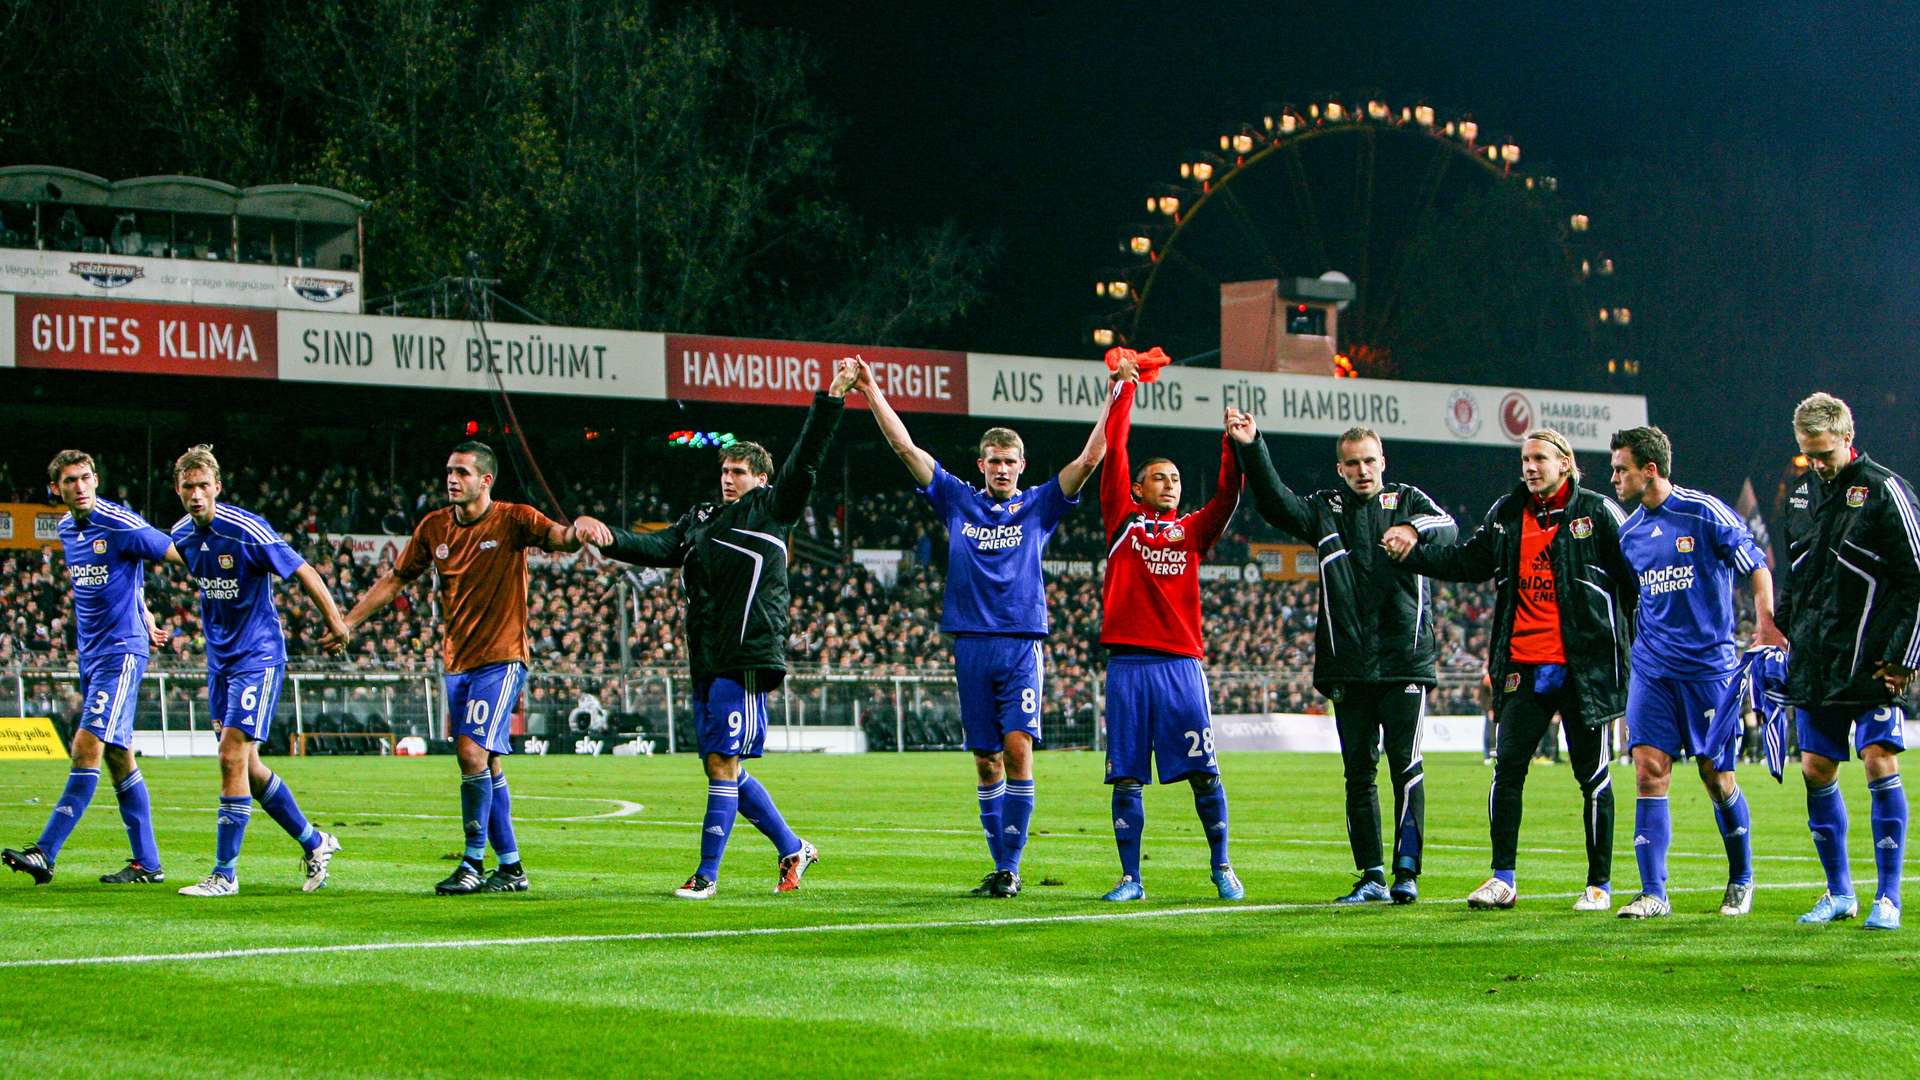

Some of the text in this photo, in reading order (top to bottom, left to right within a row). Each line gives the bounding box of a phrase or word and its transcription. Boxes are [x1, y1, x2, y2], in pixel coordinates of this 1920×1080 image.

[32, 313, 258, 362] GUTES KLIMA
[303, 329, 618, 381] SIND WIR BERÜHMT.
[683, 350, 821, 392] HAMBURG
[992, 369, 1043, 403] AUS
[1222, 380, 1267, 417] FÜR
[1283, 388, 1407, 425] HAMBURG.
[1540, 401, 1611, 421] HAMBURG
[977, 536, 1023, 550] ENERGY
[1145, 561, 1187, 575] NERGY
[1651, 577, 1695, 596] ENERGY
[89, 690, 110, 715] 3
[240, 685, 258, 711] 6
[1021, 688, 1037, 714] 8
[465, 699, 489, 725] 10
[727, 711, 743, 738] 9
[524, 736, 549, 756] sky
[575, 736, 603, 757] sky
[628, 736, 656, 757] sky
[1183, 727, 1215, 758] 28
